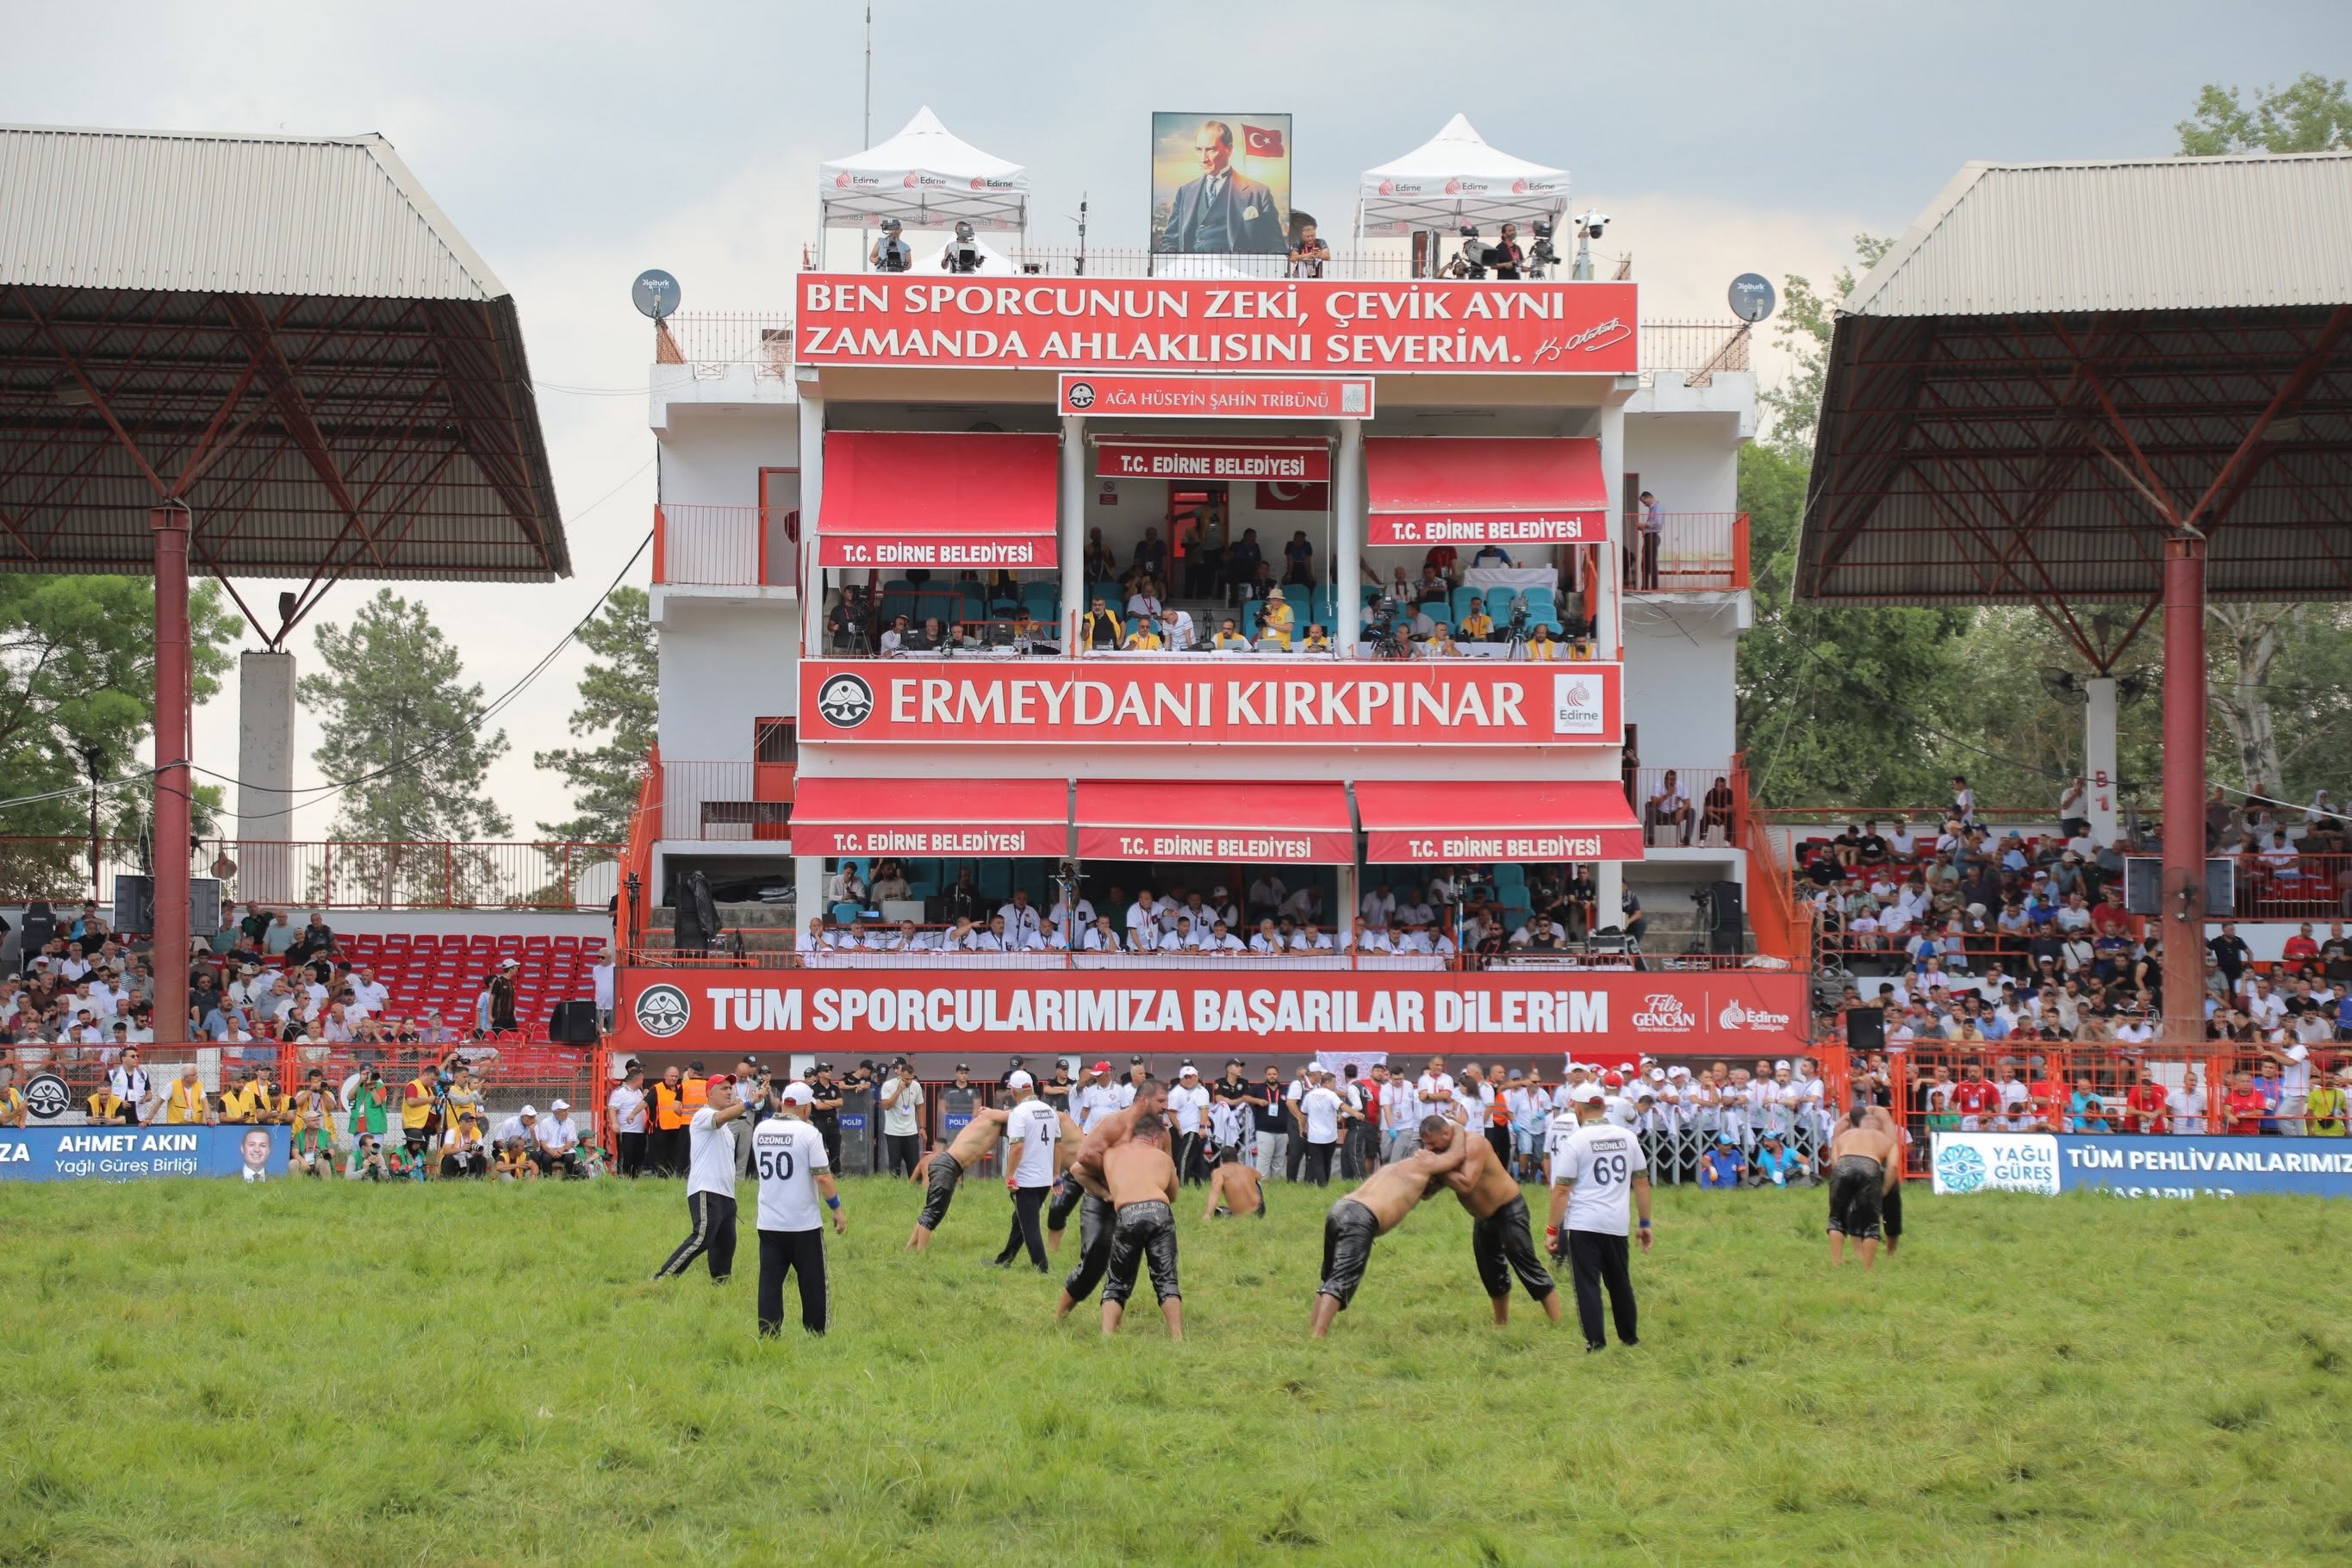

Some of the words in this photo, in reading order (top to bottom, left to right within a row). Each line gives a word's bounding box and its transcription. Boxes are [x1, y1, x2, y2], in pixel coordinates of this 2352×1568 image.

[986, 179, 1013, 188] Edirne
[1395, 184, 1422, 192] Edirne
[806, 283, 888, 313] BEN
[904, 286, 1188, 318] SPORCUNUN
[1204, 284, 1308, 326] ZEKİ,
[1325, 284, 1452, 327] ÇEVİK
[1463, 291, 1564, 320] AYNI
[803, 327, 1029, 358] ZAMANDA
[1039, 331, 1311, 363] AHLAKLISINI
[1326, 327, 1521, 364] SEVERİM.
[1105, 389, 1136, 406] AĞA
[1142, 390, 1205, 407] HÜSEYİN
[1210, 391, 1257, 410] ŞAHİN
[1261, 391, 1328, 408] TRİBÜNÜ
[1122, 455, 1148, 472] T.C.
[1154, 453, 1210, 474] EDİRNE
[1215, 455, 1305, 476] BELEDİYESİ
[1392, 522, 1421, 540] T.C.
[1425, 518, 1484, 540] EDİRNE
[1489, 517, 1582, 538] BELEDİYESİ
[843, 544, 871, 562] T.C.
[876, 542, 936, 563] EDİRNE
[940, 542, 1033, 563] BELEDİYESİ
[891, 678, 1212, 727] ERMEYDANI
[1227, 681, 1528, 727] KIRKPINAR
[1559, 710, 1599, 720] Edirne
[834, 833, 862, 851] T.C.
[868, 830, 927, 851] EDİRNE
[931, 830, 1026, 852] BELEDİYESİ
[1121, 837, 1148, 856] T.C.
[1154, 834, 1213, 856] EDİRNE
[1218, 836, 1311, 858] BELEDİYESİ
[1409, 839, 1438, 857] T.C.
[1443, 836, 1503, 857] EDİRNE
[1508, 835, 1601, 856] BELEDİYESİ
[707, 987, 802, 1031] TÜM
[812, 988, 1184, 1033] SPORCULARIMIZA
[1194, 989, 1424, 1036] BAŞARILAR
[1434, 990, 1608, 1033] DİLERİM
[1645, 994, 1683, 1015] Filiz
[1633, 1012, 1696, 1026] GENCAN
[1746, 1011, 1789, 1024] Edirne
[58, 1135, 138, 1153] AHMET
[141, 1133, 197, 1151] AKIN
[758, 1136, 792, 1145] ÖZÜNLÜ
[1041, 1123, 1049, 1146] 4
[1993, 1144, 2051, 1161] YAĞLI
[2067, 1144, 2123, 1168] TÜM
[2128, 1147, 2352, 1173] PEHLİVANLARIMIZ
[55, 1159, 96, 1176] Yağlı
[100, 1158, 149, 1175] Güreş
[153, 1157, 197, 1174] Birliği
[760, 1151, 793, 1180] 50
[1593, 1154, 1627, 1185] 69
[1994, 1163, 2052, 1183] GÜREŞ
